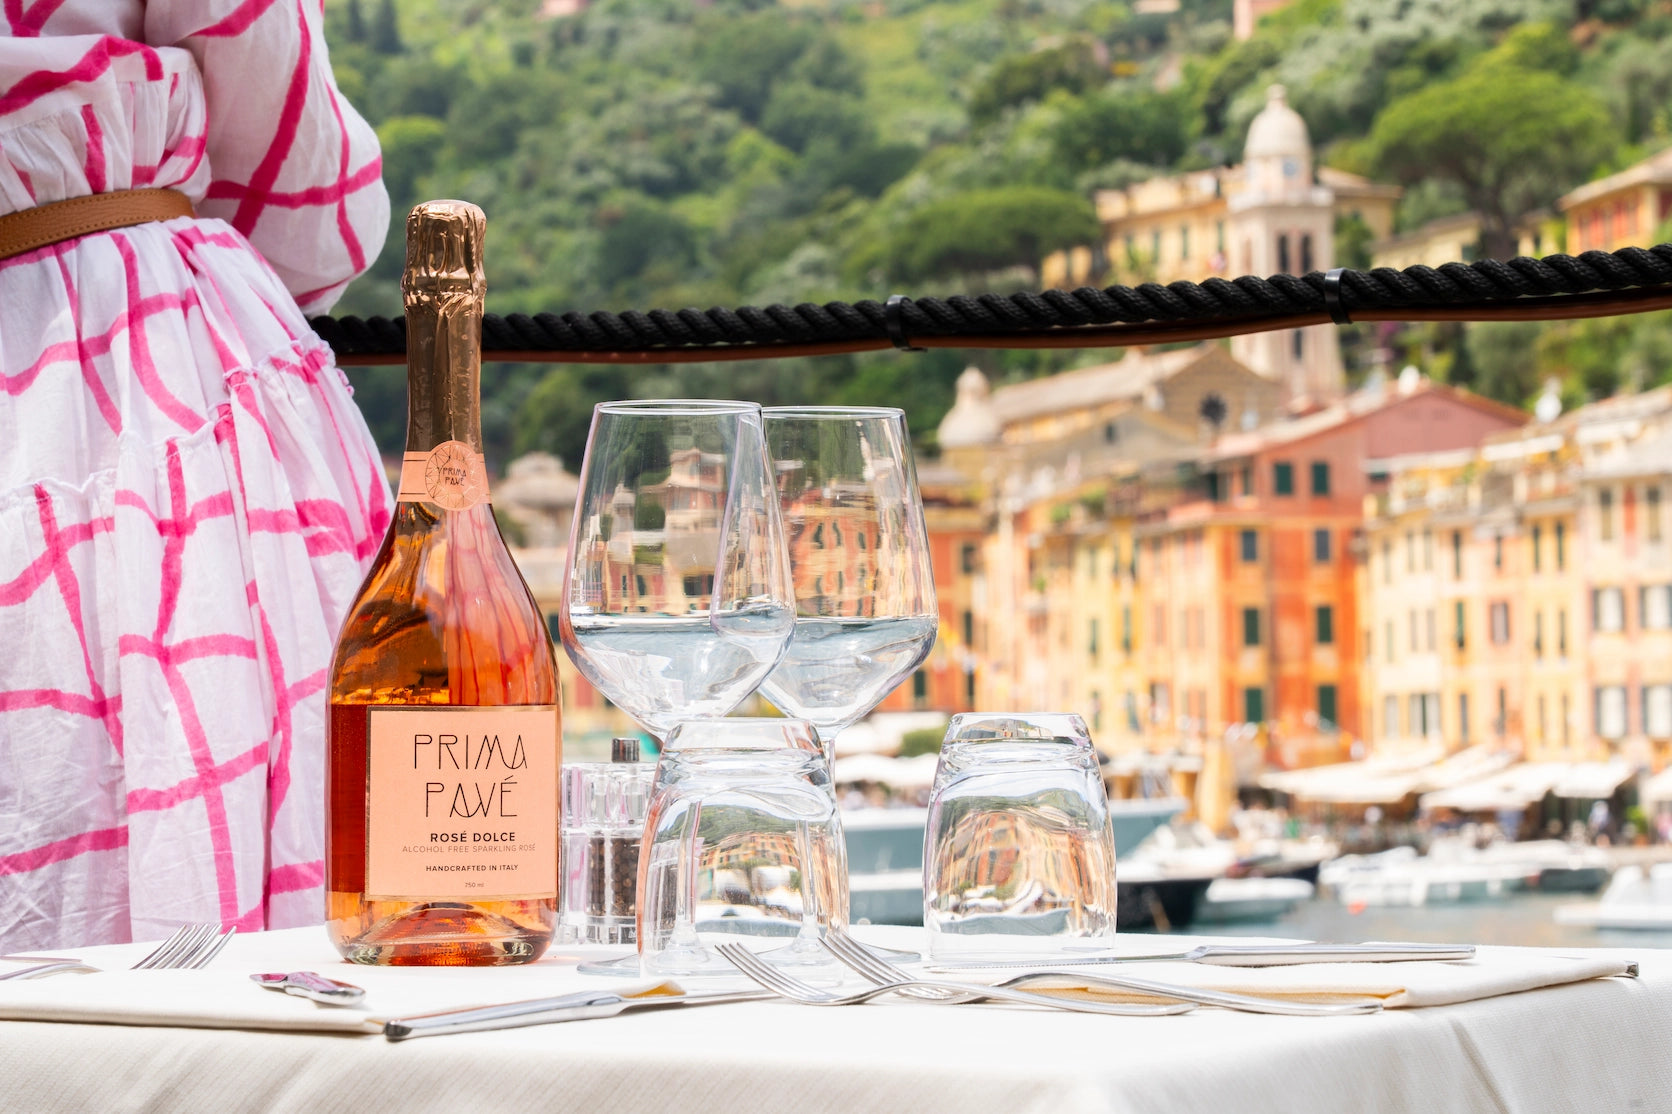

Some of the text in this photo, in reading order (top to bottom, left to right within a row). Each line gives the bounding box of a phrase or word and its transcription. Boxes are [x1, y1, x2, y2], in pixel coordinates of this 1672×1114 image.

[443, 467, 467, 477] PRIMA
[414, 734, 528, 770] PRIMA
[425, 774, 518, 818] PAVÉ
[430, 831, 516, 843] ROSÉ DOLCE
[402, 843, 536, 853] ALCOHOL FREE SPARKLING ROSÉ
